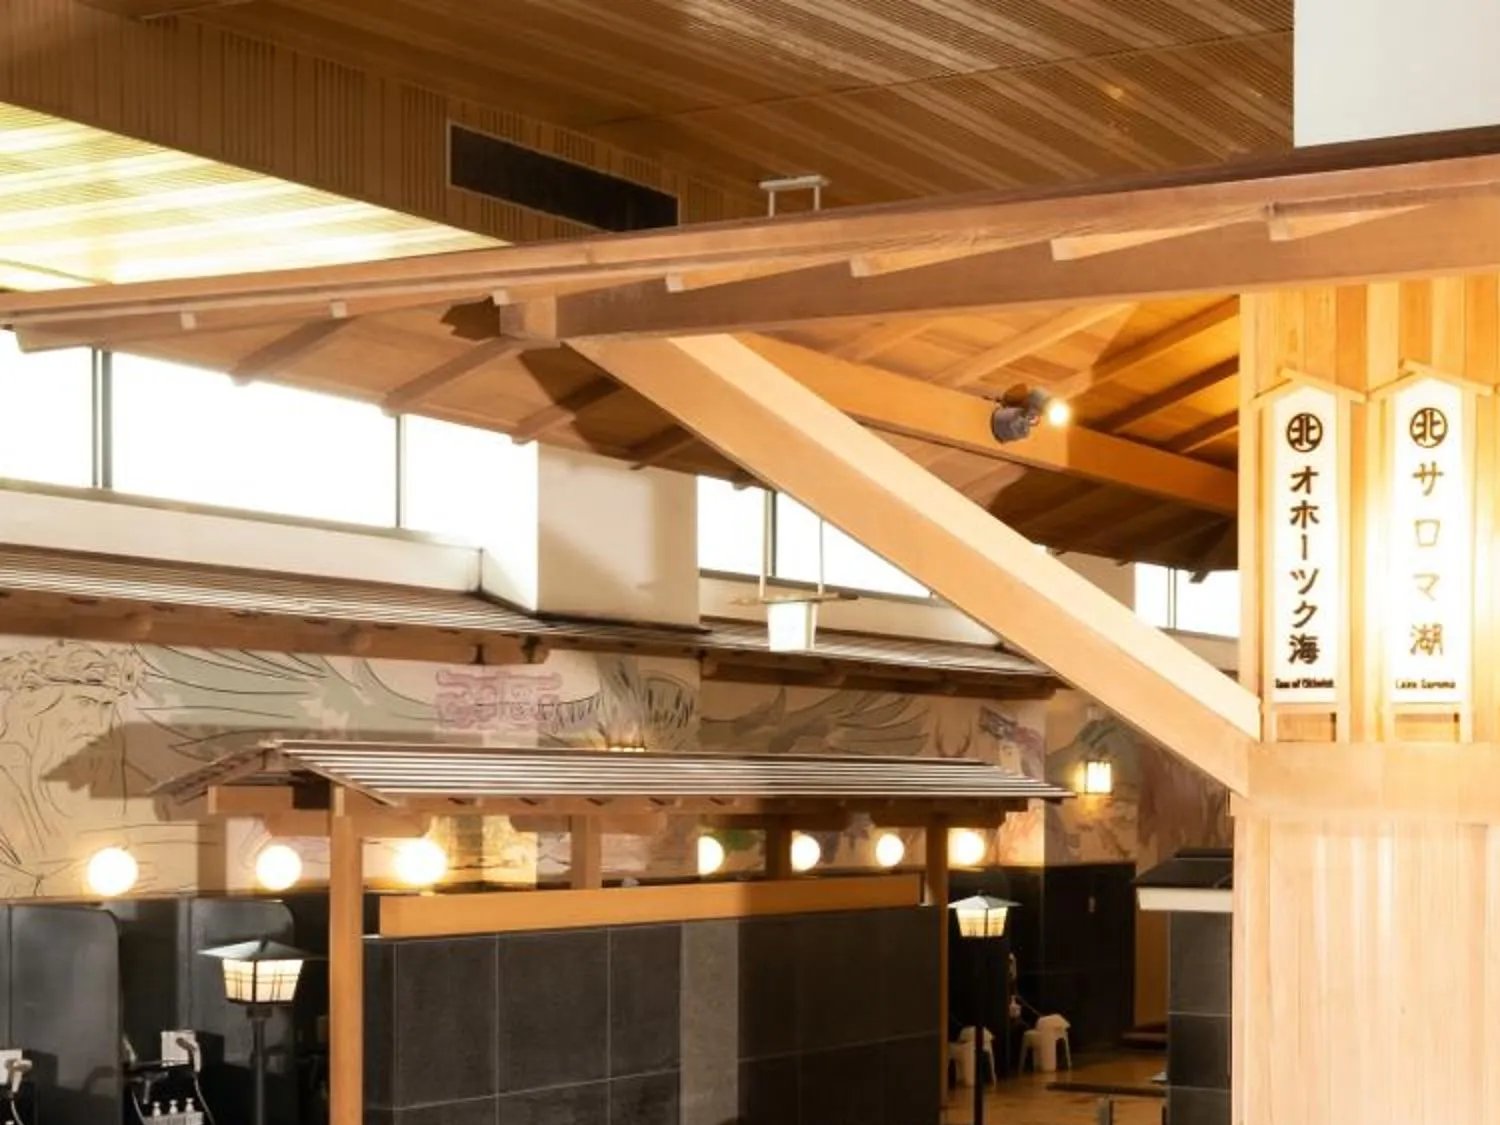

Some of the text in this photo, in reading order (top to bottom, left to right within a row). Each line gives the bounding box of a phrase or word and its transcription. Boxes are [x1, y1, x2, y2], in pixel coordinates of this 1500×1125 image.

[1288, 466, 1320, 665] オホーツク海
[1410, 462, 1444, 656] サロマ湖
